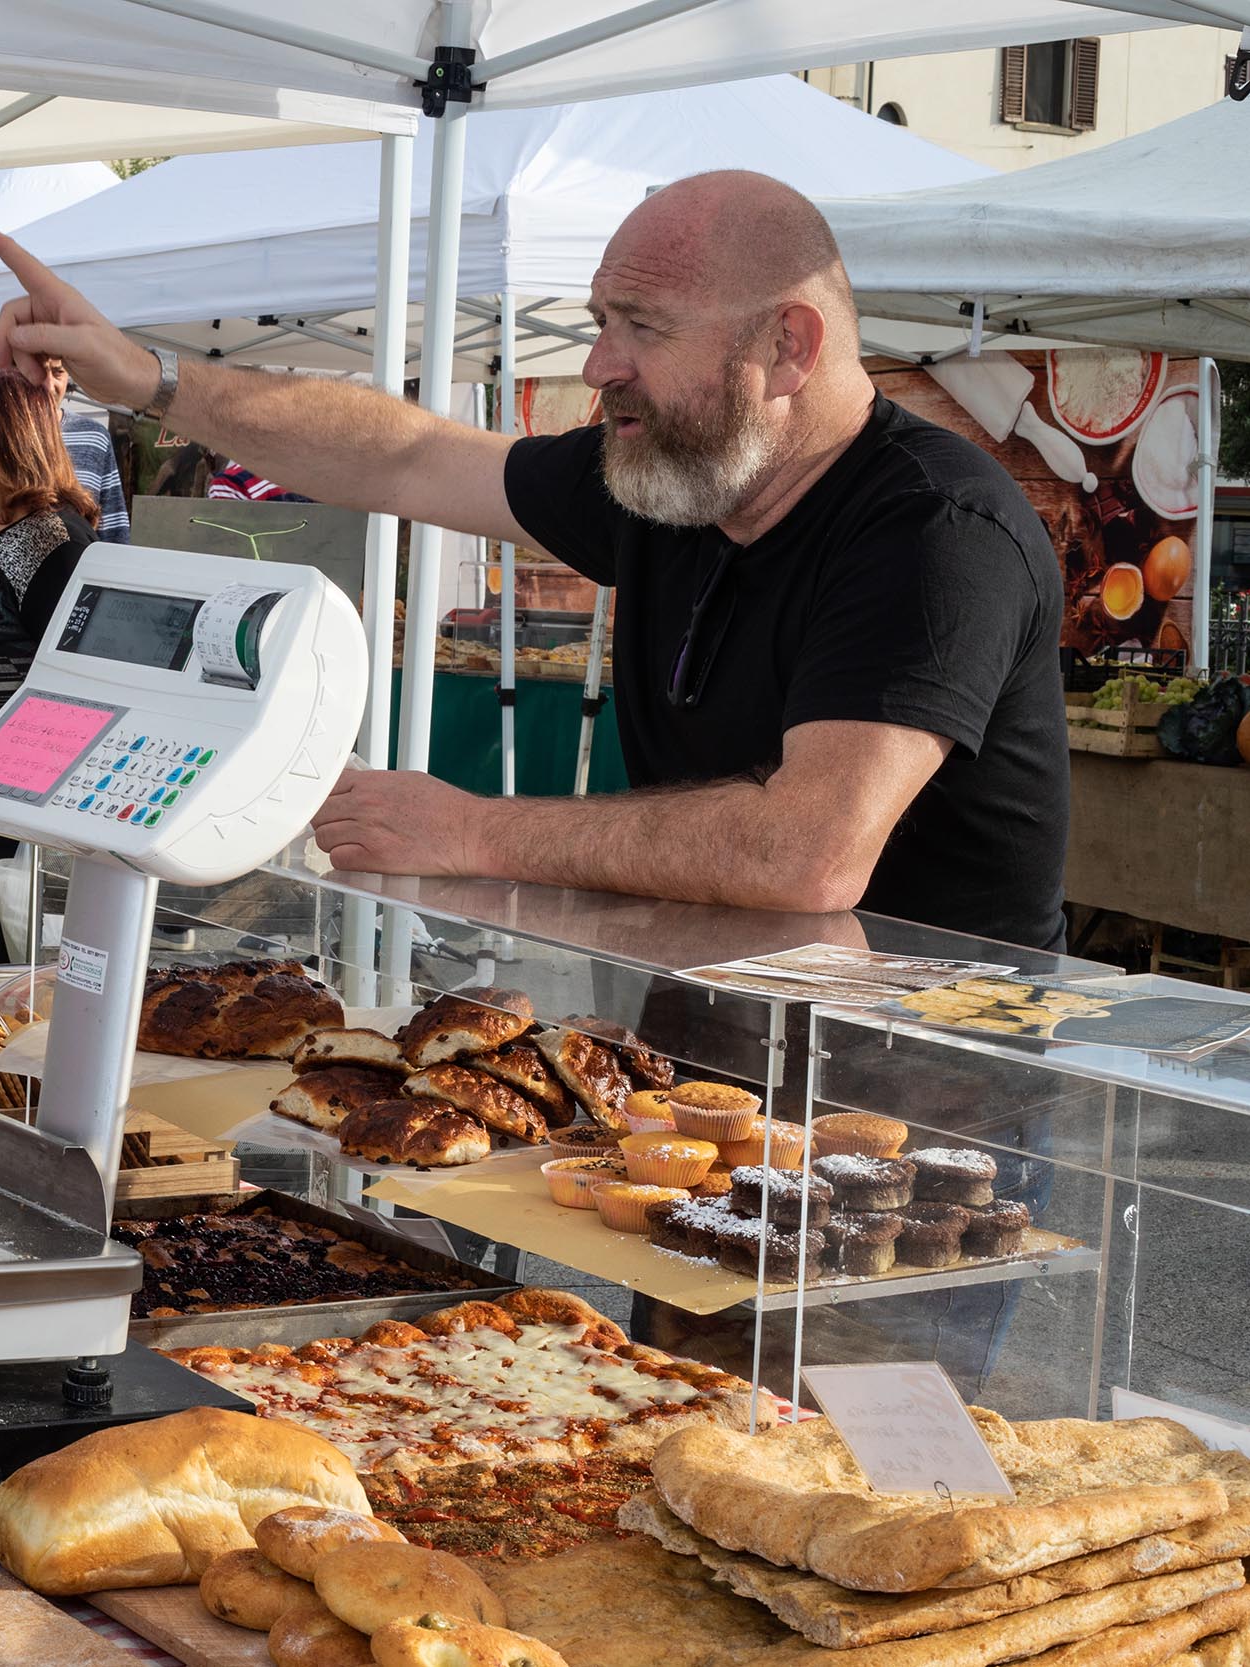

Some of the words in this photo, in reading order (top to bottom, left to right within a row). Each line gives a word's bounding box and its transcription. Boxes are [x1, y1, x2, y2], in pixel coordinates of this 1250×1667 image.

[113, 782, 120, 790] 1
[125, 784, 134, 794] 2
[139, 787, 147, 797] 3
[95, 801, 104, 810] 0
[107, 804, 119, 813] 00
